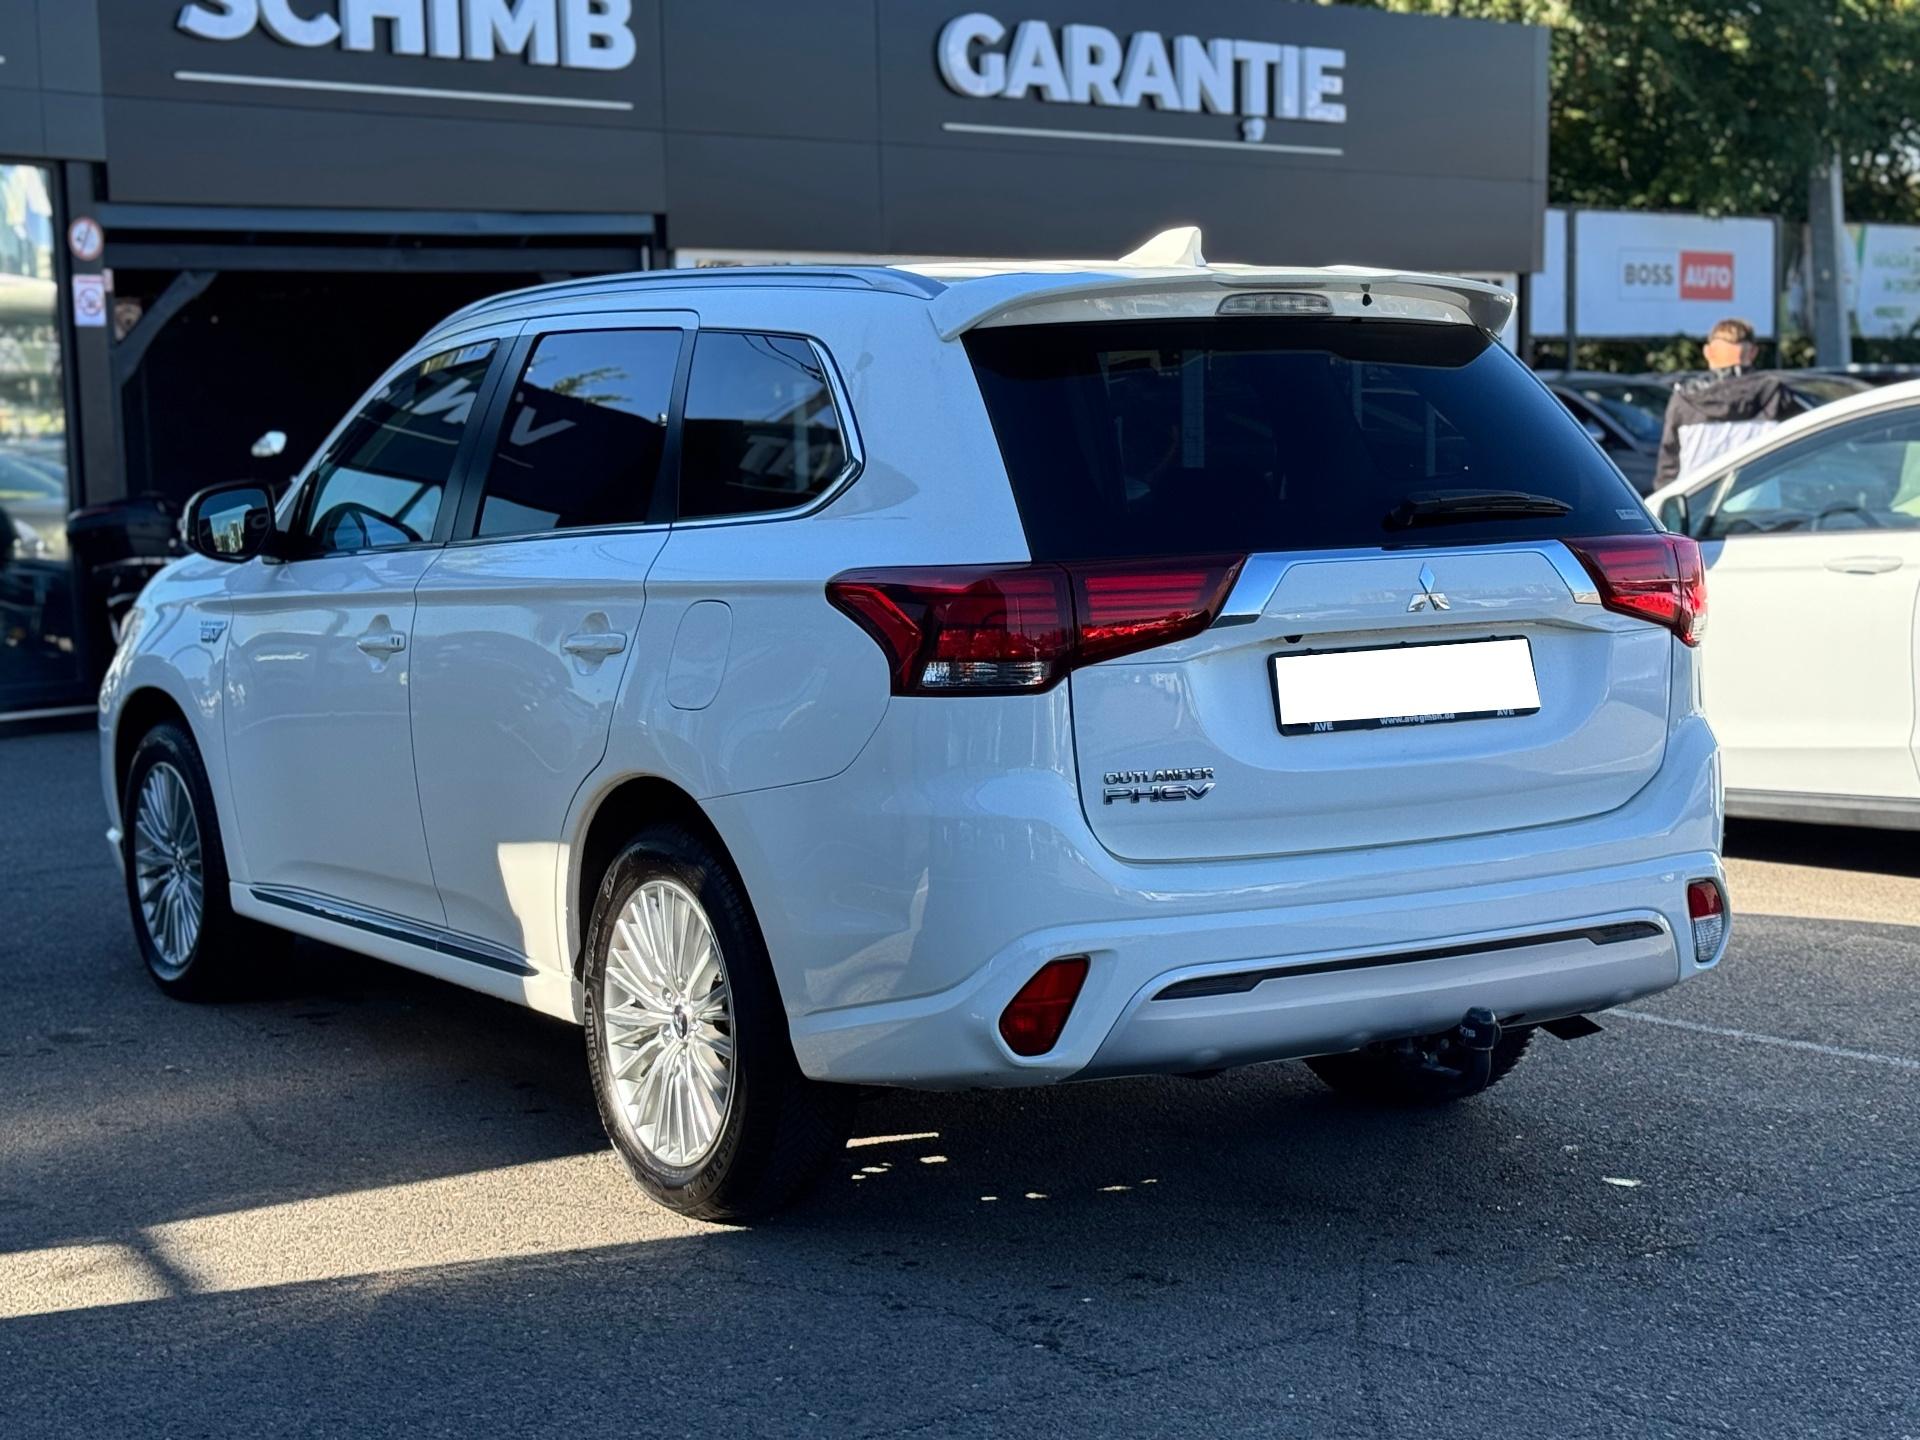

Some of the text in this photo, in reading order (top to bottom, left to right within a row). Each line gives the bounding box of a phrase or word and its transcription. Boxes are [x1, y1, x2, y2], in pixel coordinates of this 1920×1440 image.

[938, 13, 1346, 142] GARANȚIE
[1624, 263, 1732, 289] BOSS AUTO
[1496, 708, 1515, 717] AVE
[1313, 721, 1334, 732] AVE
[1103, 767, 1215, 785] OUTLANDER
[1103, 782, 1216, 805] PHEV
